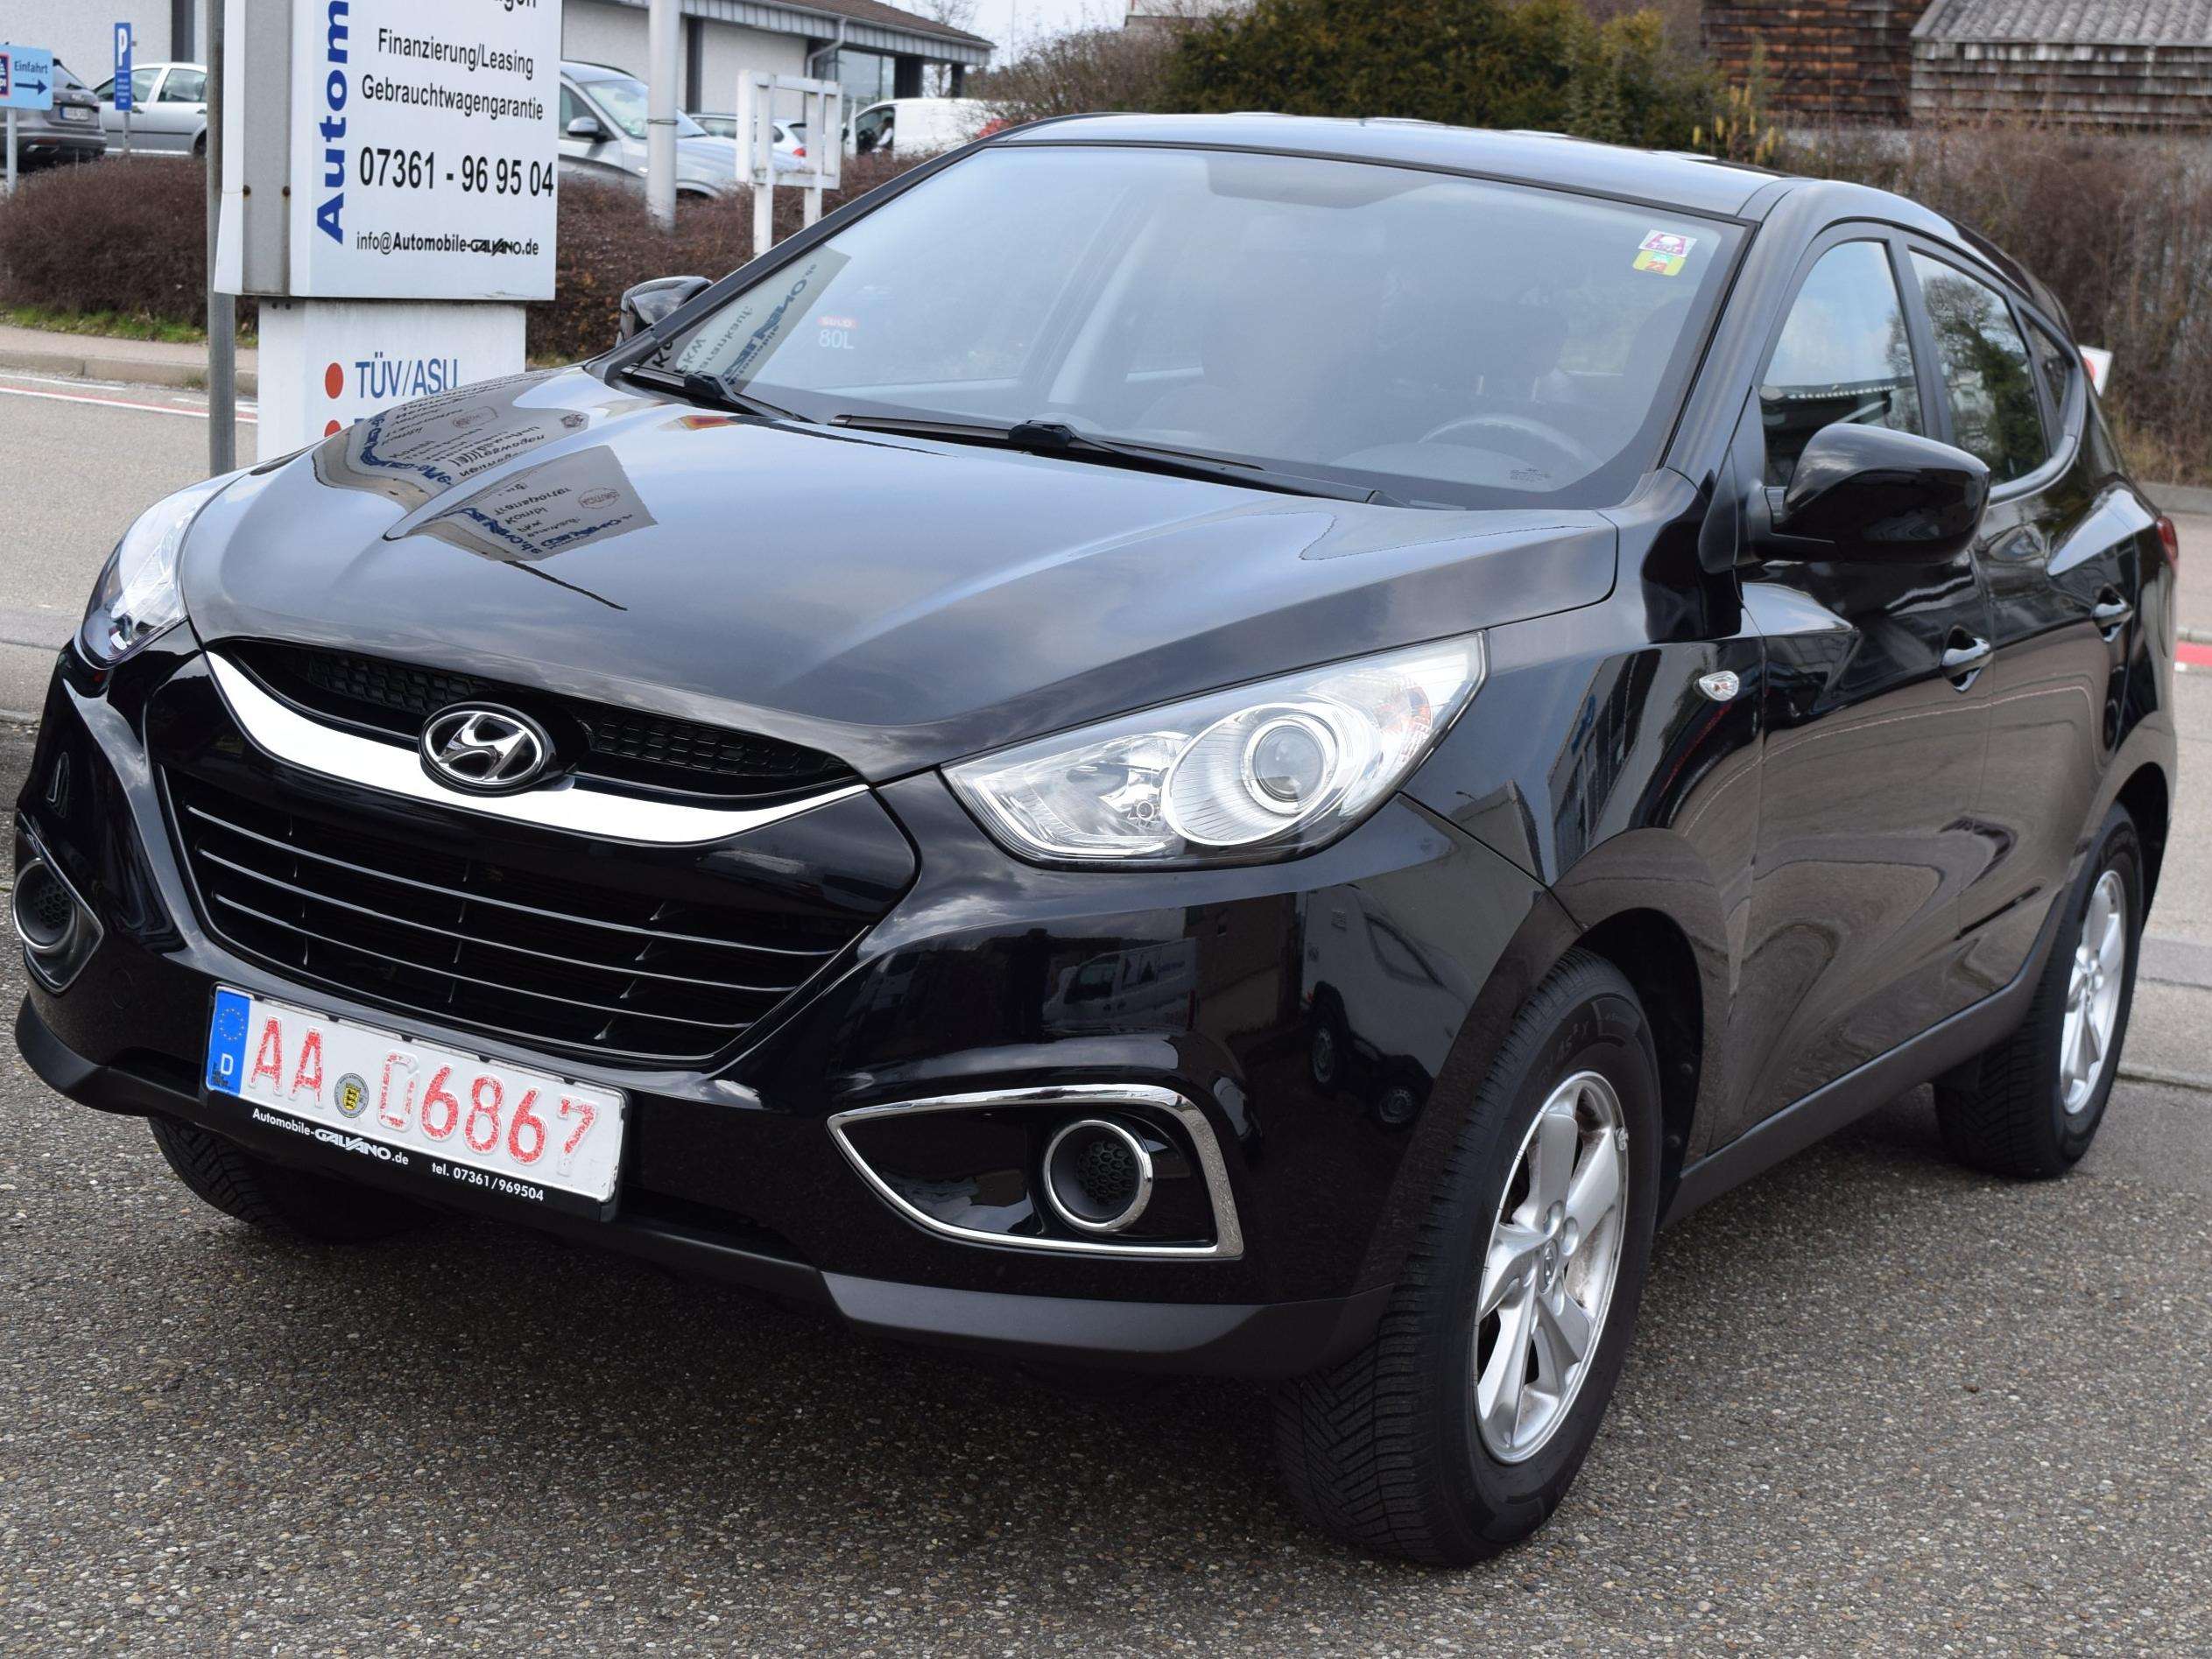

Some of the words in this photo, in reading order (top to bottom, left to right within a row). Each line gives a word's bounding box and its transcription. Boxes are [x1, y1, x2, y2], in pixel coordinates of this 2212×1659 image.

[14, 60, 48, 74] Einfahrt
[117, 28, 128, 67] P
[378, 27, 534, 81] Finanzierung/Leasing
[362, 74, 544, 121] Gebrauchtwagengarantie
[316, 0, 349, 245] Autom
[359, 146, 435, 190] 07361
[461, 154, 489, 193] 96
[496, 158, 522, 195] 95
[530, 160, 554, 197] 04
[356, 230, 539, 257] info@Automobile-GALVANO.de
[355, 351, 457, 398] TÜV/ASU
[221, 1052, 234, 1076] D
[250, 1014, 324, 1109] AA
[431, 1162, 449, 1177] tel.
